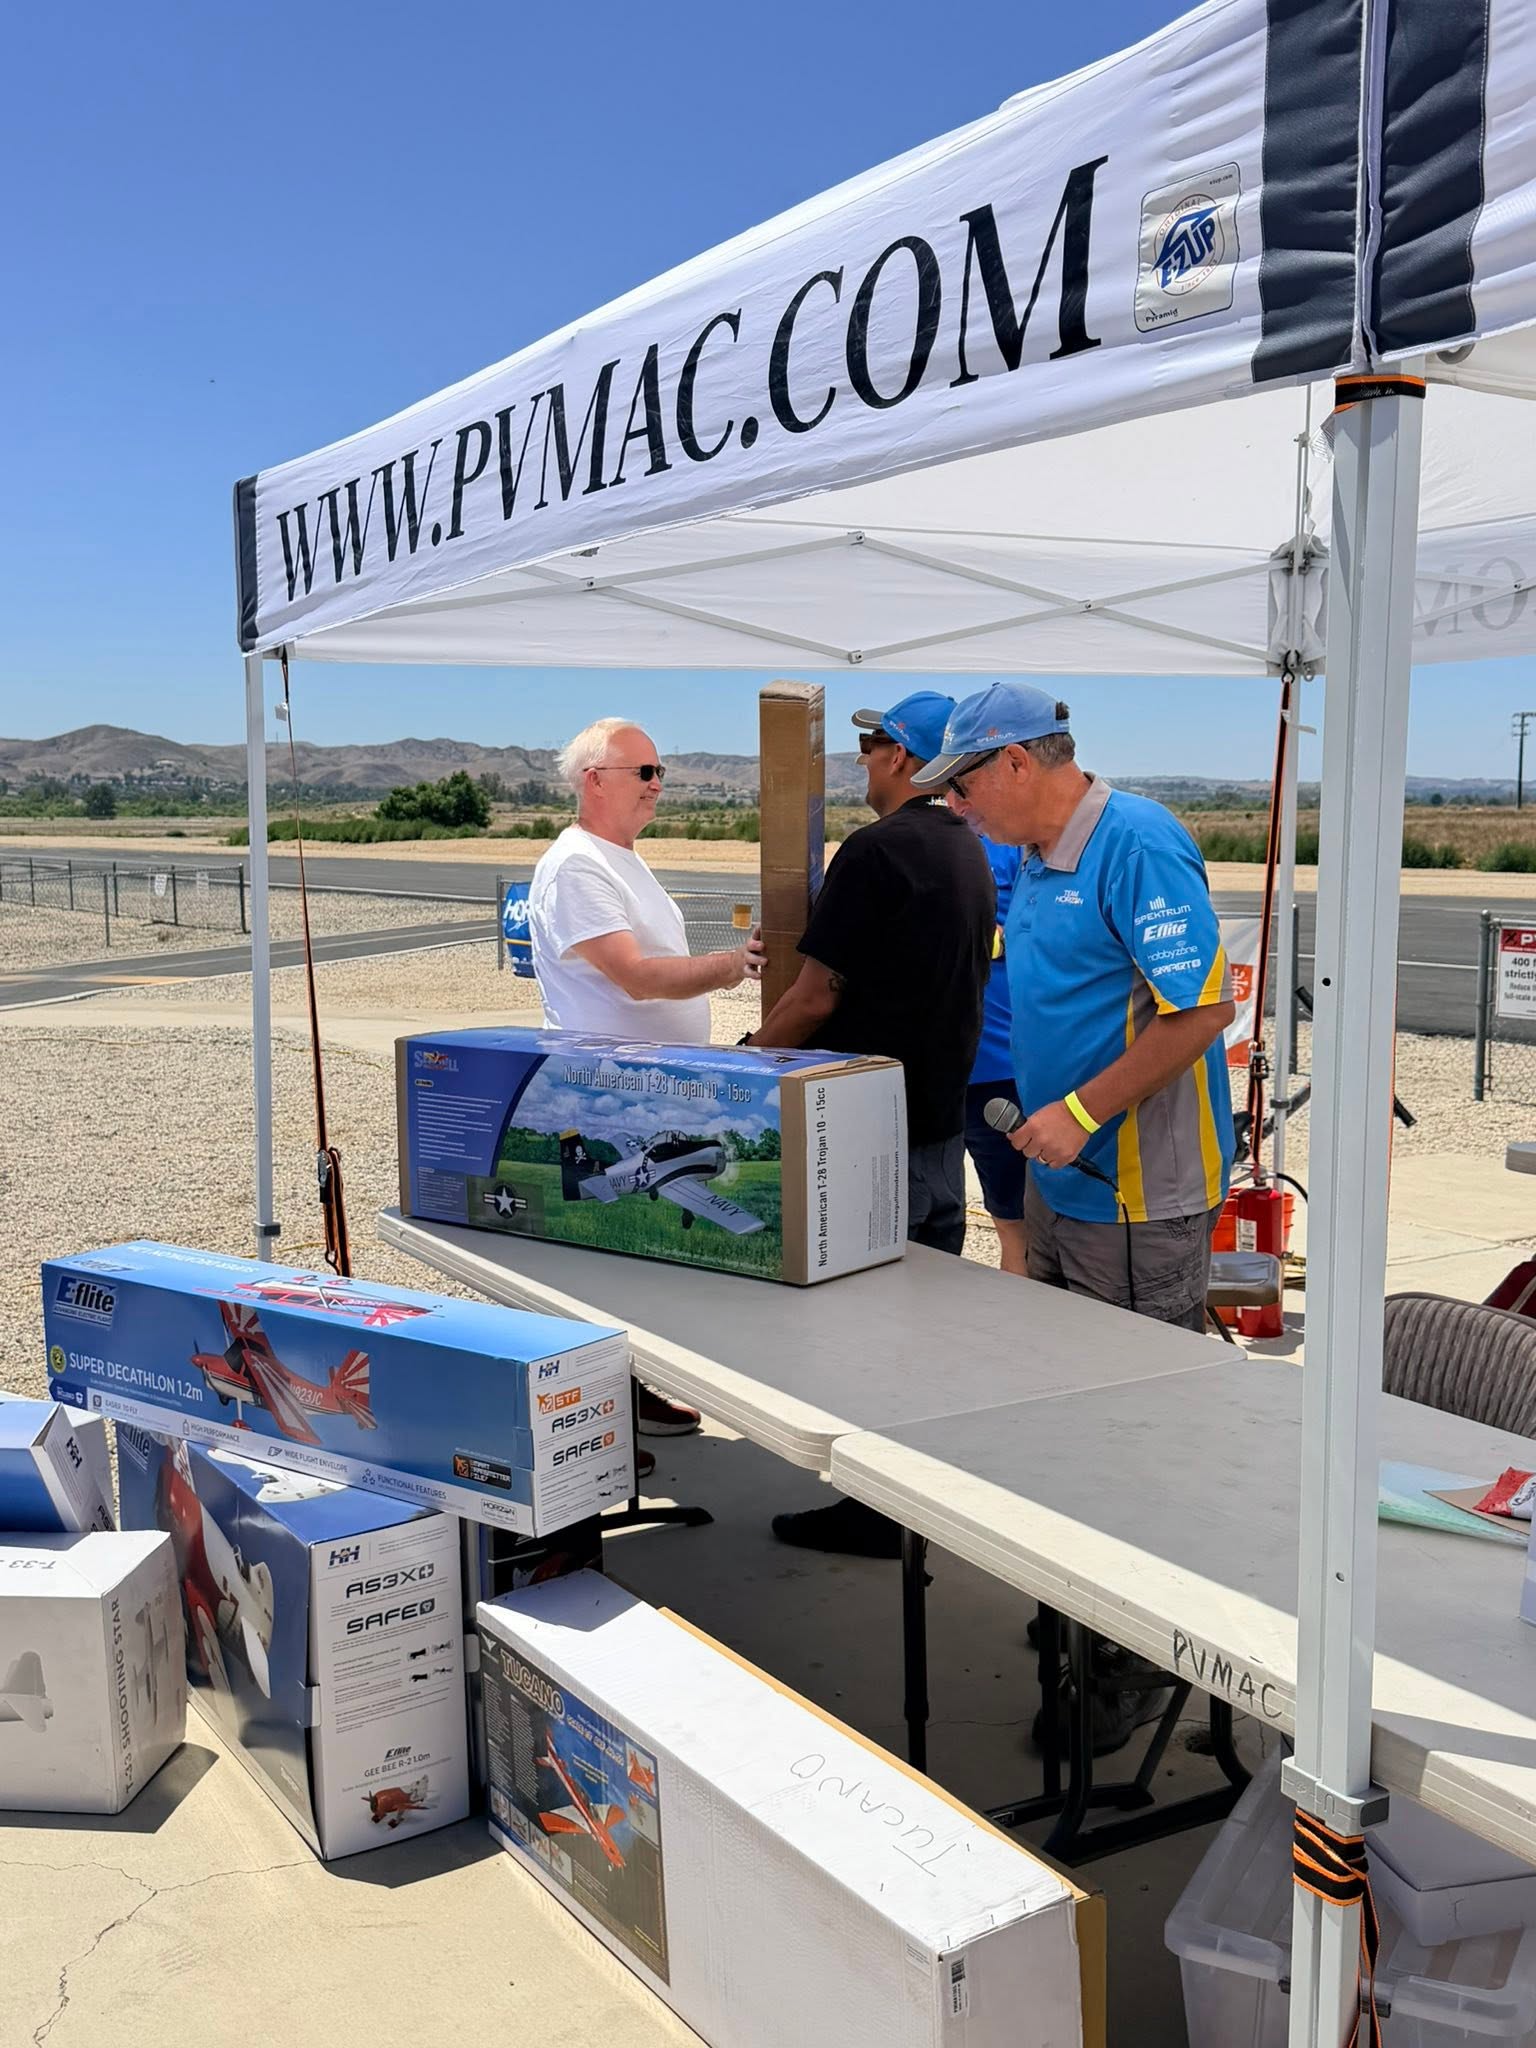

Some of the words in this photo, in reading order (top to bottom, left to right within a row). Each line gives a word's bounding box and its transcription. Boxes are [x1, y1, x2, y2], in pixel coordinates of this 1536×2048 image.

[276, 155, 1109, 602] WWW.PVMAC.COM
[1134, 904, 1192, 926] SPEKTRUM
[564, 1064, 593, 1086] North
[595, 1068, 643, 1092] American
[645, 1074, 668, 1095] T-28
[670, 1075, 704, 1100] Trojan
[705, 1081, 718, 1099] 10
[727, 1083, 751, 1103] 15cc
[816, 1087, 826, 1111] 15cc
[817, 1121, 826, 1134] 10
[817, 1135, 828, 1167] Trojan
[818, 1168, 828, 1190] T-28
[706, 1194, 745, 1217] NAVY
[818, 1191, 828, 1237] American
[818, 1238, 828, 1267] North
[69, 1352, 105, 1374] SUPER
[107, 1361, 176, 1391] DECATHLON
[176, 1380, 203, 1401] 1.2m
[552, 1404, 602, 1433] AS3X
[553, 1435, 603, 1466] SAFE
[378, 1474, 415, 1492] FUNCTIONAL
[416, 1484, 447, 1500] FEATURES
[346, 1568, 417, 1598] AS3X
[111, 1599, 123, 1646] STAR
[347, 1603, 418, 1634] SAFE
[501, 1649, 565, 1720] TUCANO
[1173, 1630, 1283, 1719] PVMAC
[116, 1654, 131, 1750] SHOOTING
[364, 1767, 381, 1777] GEE
[381, 1762, 397, 1773] BEE
[398, 1758, 412, 1767] R-2
[790, 1754, 956, 1877] TUCANO
